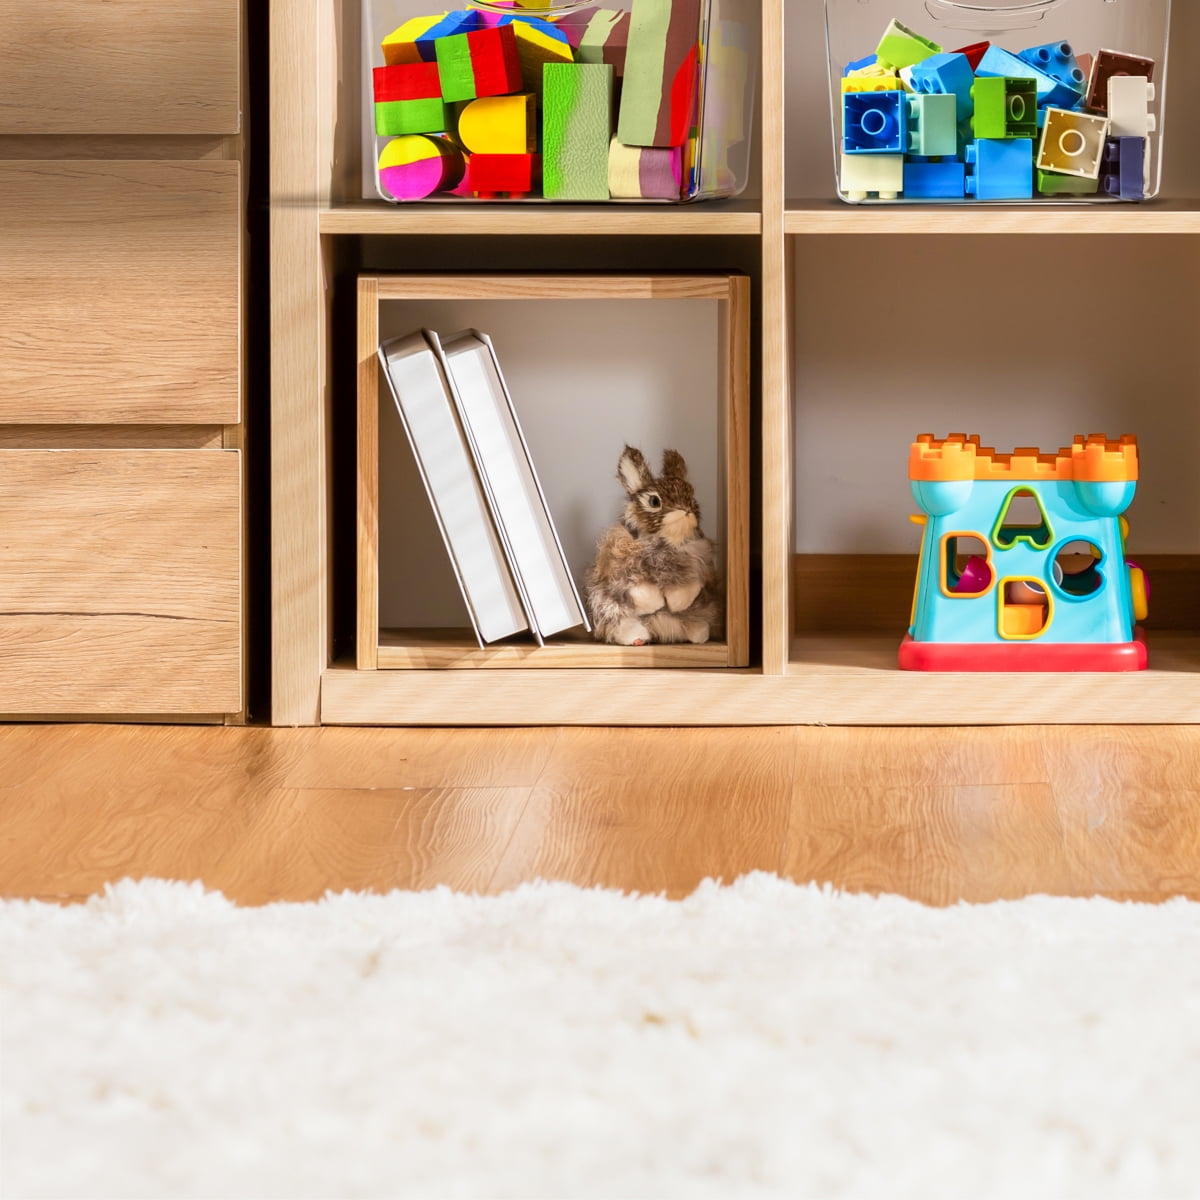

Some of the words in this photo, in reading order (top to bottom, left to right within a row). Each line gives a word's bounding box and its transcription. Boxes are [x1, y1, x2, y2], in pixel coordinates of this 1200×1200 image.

[992, 485, 1054, 550] A
[940, 530, 996, 599] B
[1048, 535, 1107, 601] C
[998, 576, 1054, 640] D
